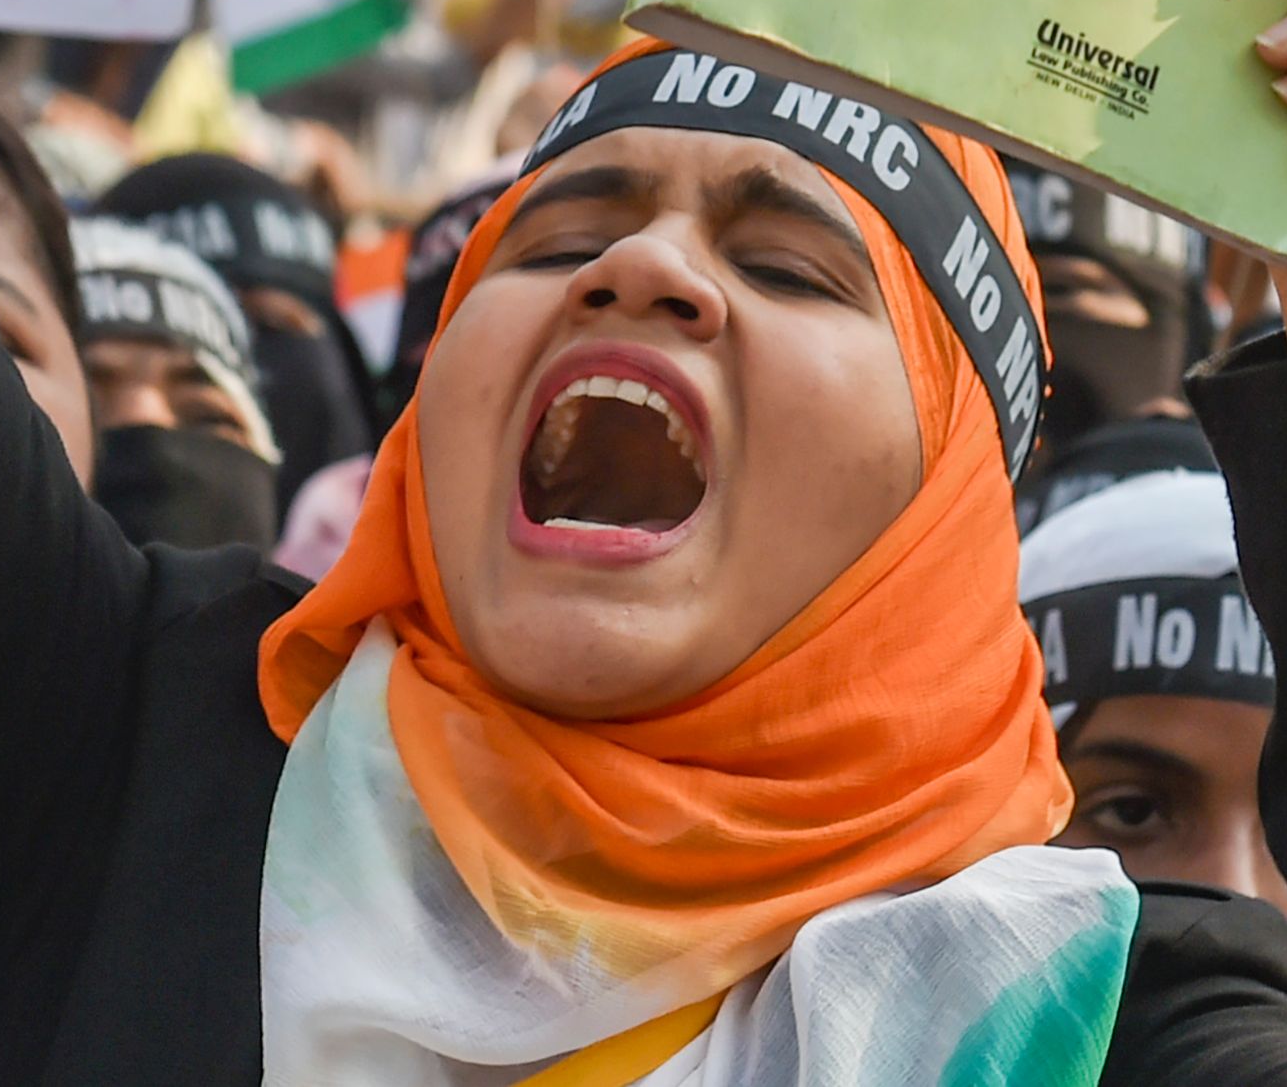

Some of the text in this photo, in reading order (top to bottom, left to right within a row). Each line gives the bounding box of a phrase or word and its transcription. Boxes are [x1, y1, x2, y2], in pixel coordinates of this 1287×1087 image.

[1031, 46, 1059, 67] Law
[1063, 59, 1129, 100] Publishing
[1036, 17, 1161, 91] Universal
[1035, 71, 1061, 89] NEW
[1064, 82, 1098, 104] DELHI
[772, 80, 921, 194] NRC
